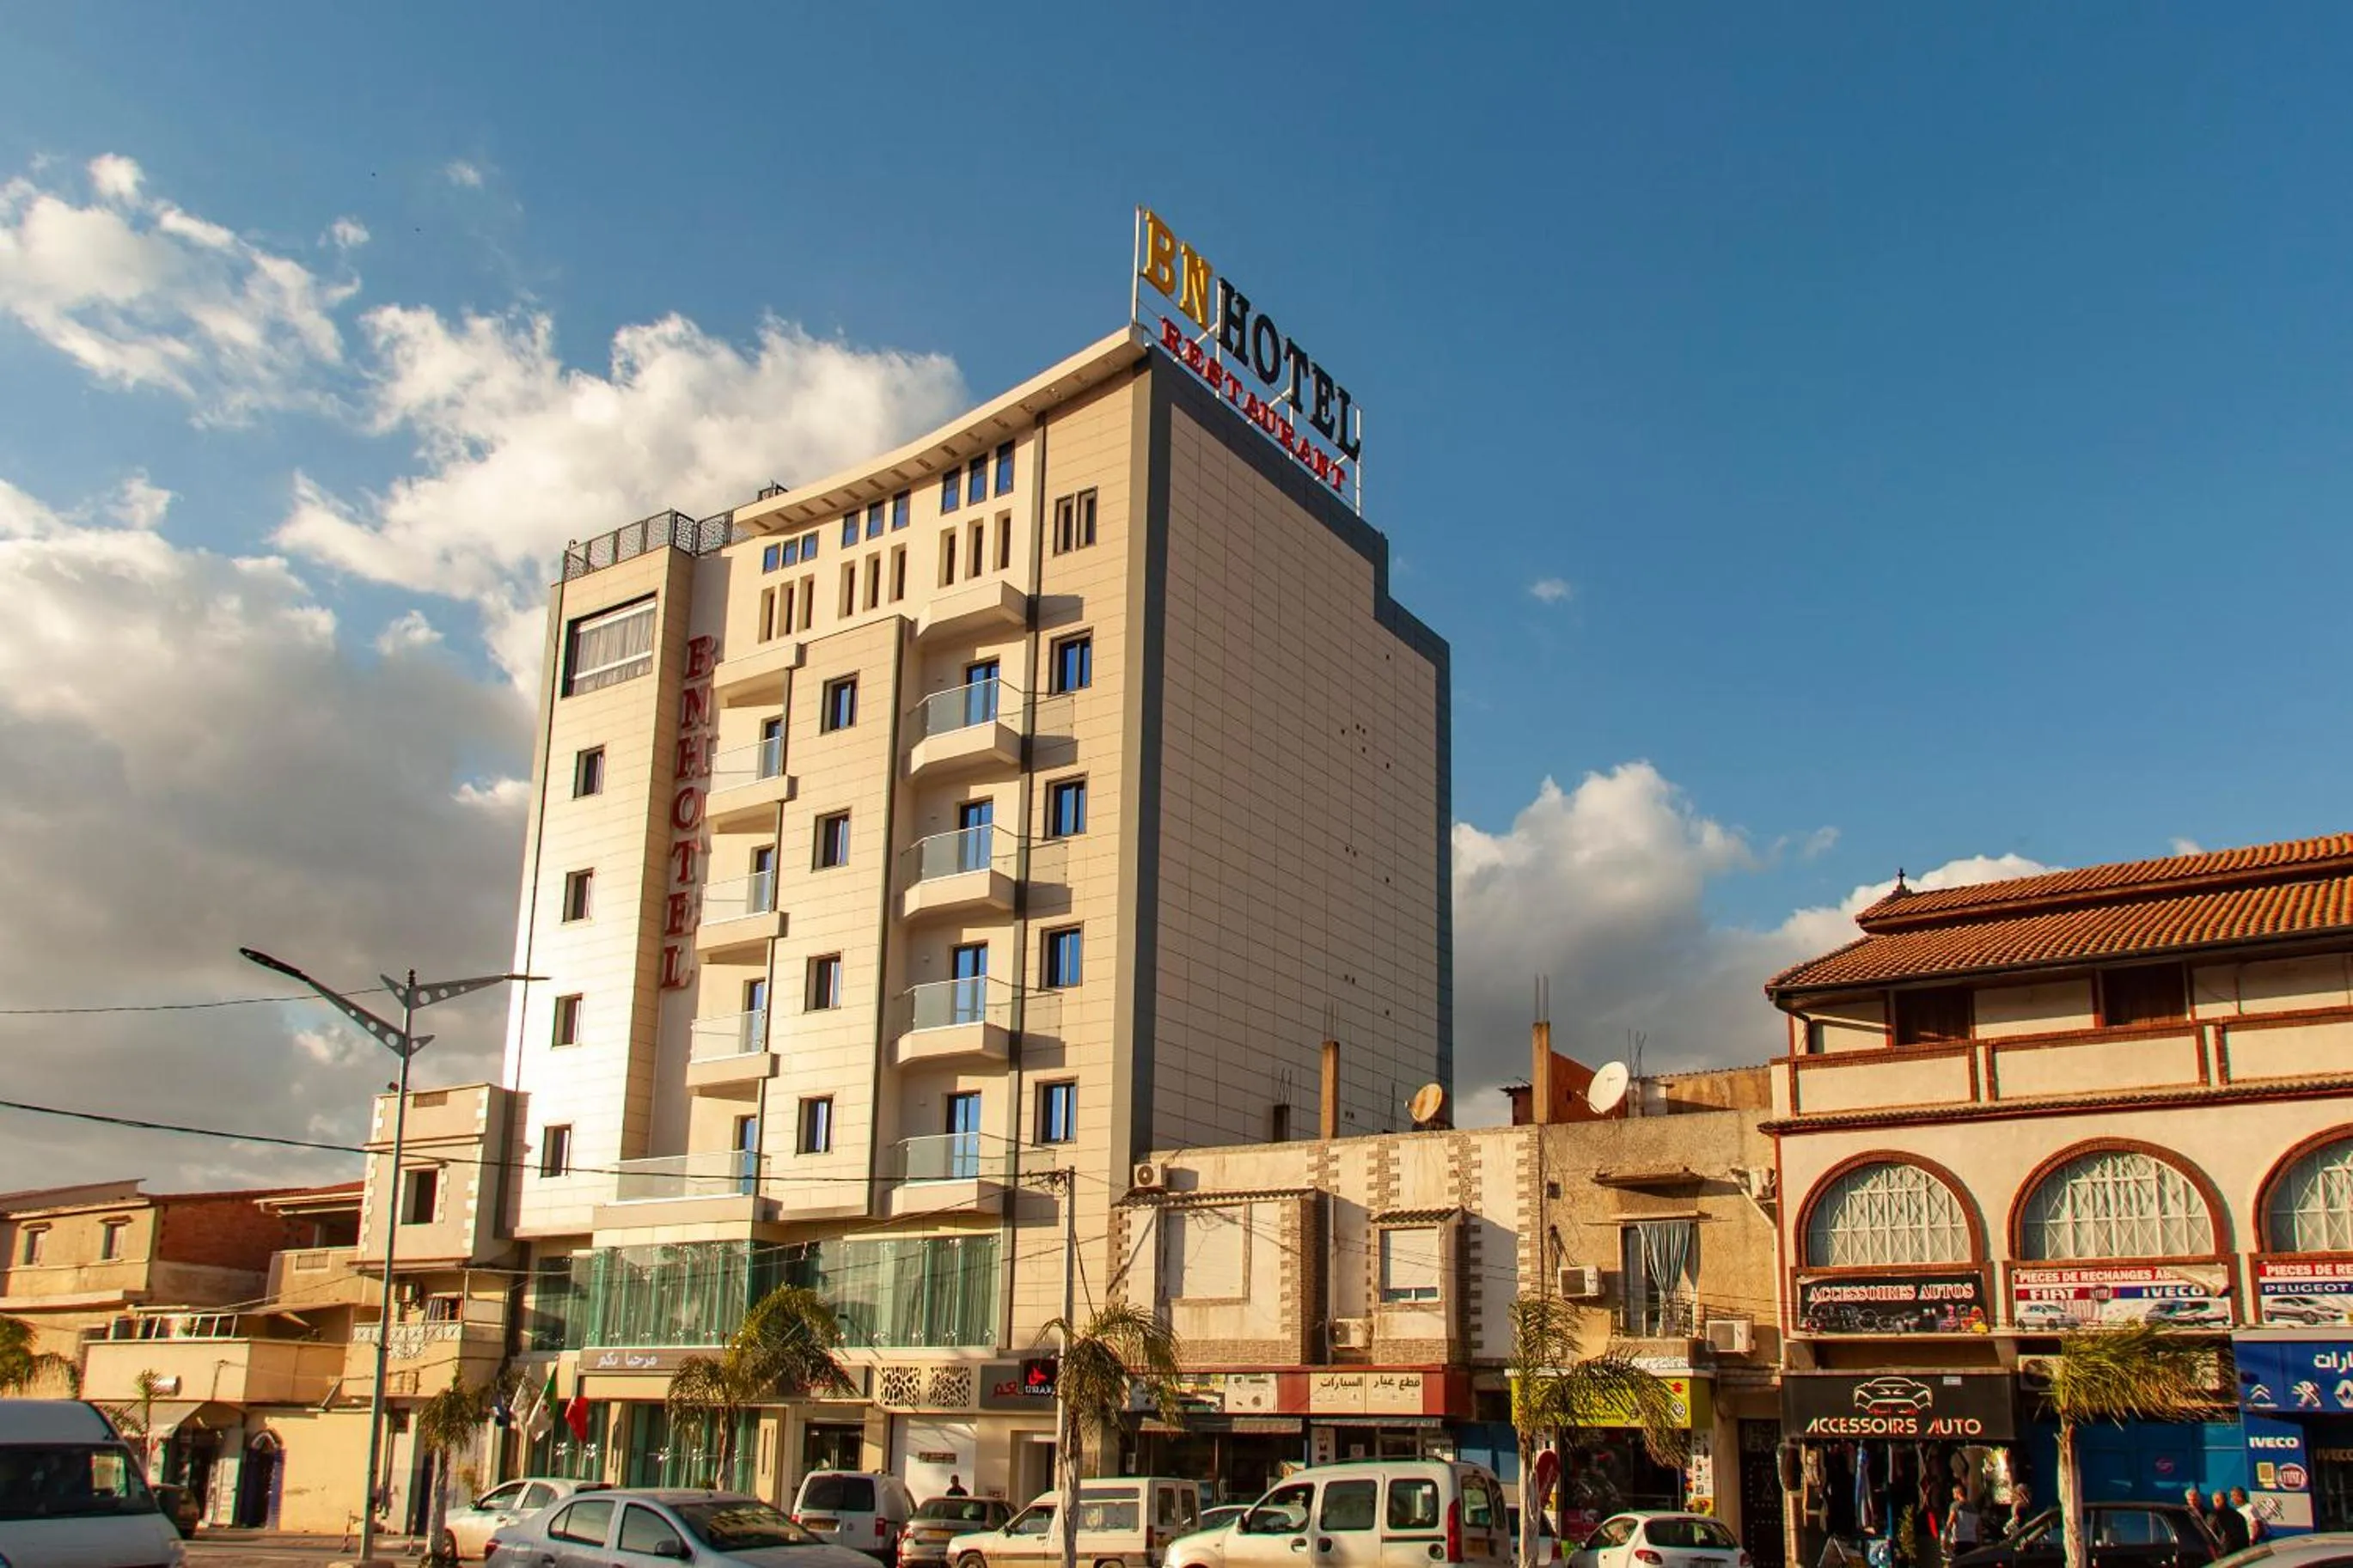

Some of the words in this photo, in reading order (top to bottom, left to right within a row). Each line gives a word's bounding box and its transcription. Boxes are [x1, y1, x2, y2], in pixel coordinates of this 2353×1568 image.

[1143, 209, 1212, 332] BN
[1218, 277, 1360, 462] HOTEL
[1160, 316, 1347, 492] RESTAURANT
[2020, 1270, 2060, 1284] PIECES
[2062, 1269, 2078, 1282] DE
[2081, 1268, 2153, 1282] RECHANGES
[2265, 1264, 2313, 1276] PIECES
[2314, 1264, 2334, 1276] DE
[1807, 1284, 1916, 1302] ACCESSOIRES
[1918, 1283, 1975, 1300] AUTOS
[2029, 1288, 2079, 1300] FIAT
[2142, 1285, 2206, 1298] IVECO
[2264, 1284, 2349, 1293] PEUGEOT
[1320, 1375, 1364, 1389] السيارات
[1373, 1375, 1396, 1388] غيار
[1399, 1377, 1421, 1391] قطع
[1806, 1418, 1918, 1434] ACCESSOIRS
[1927, 1418, 1983, 1434] AUTO
[2248, 1437, 2301, 1449] IVECO
